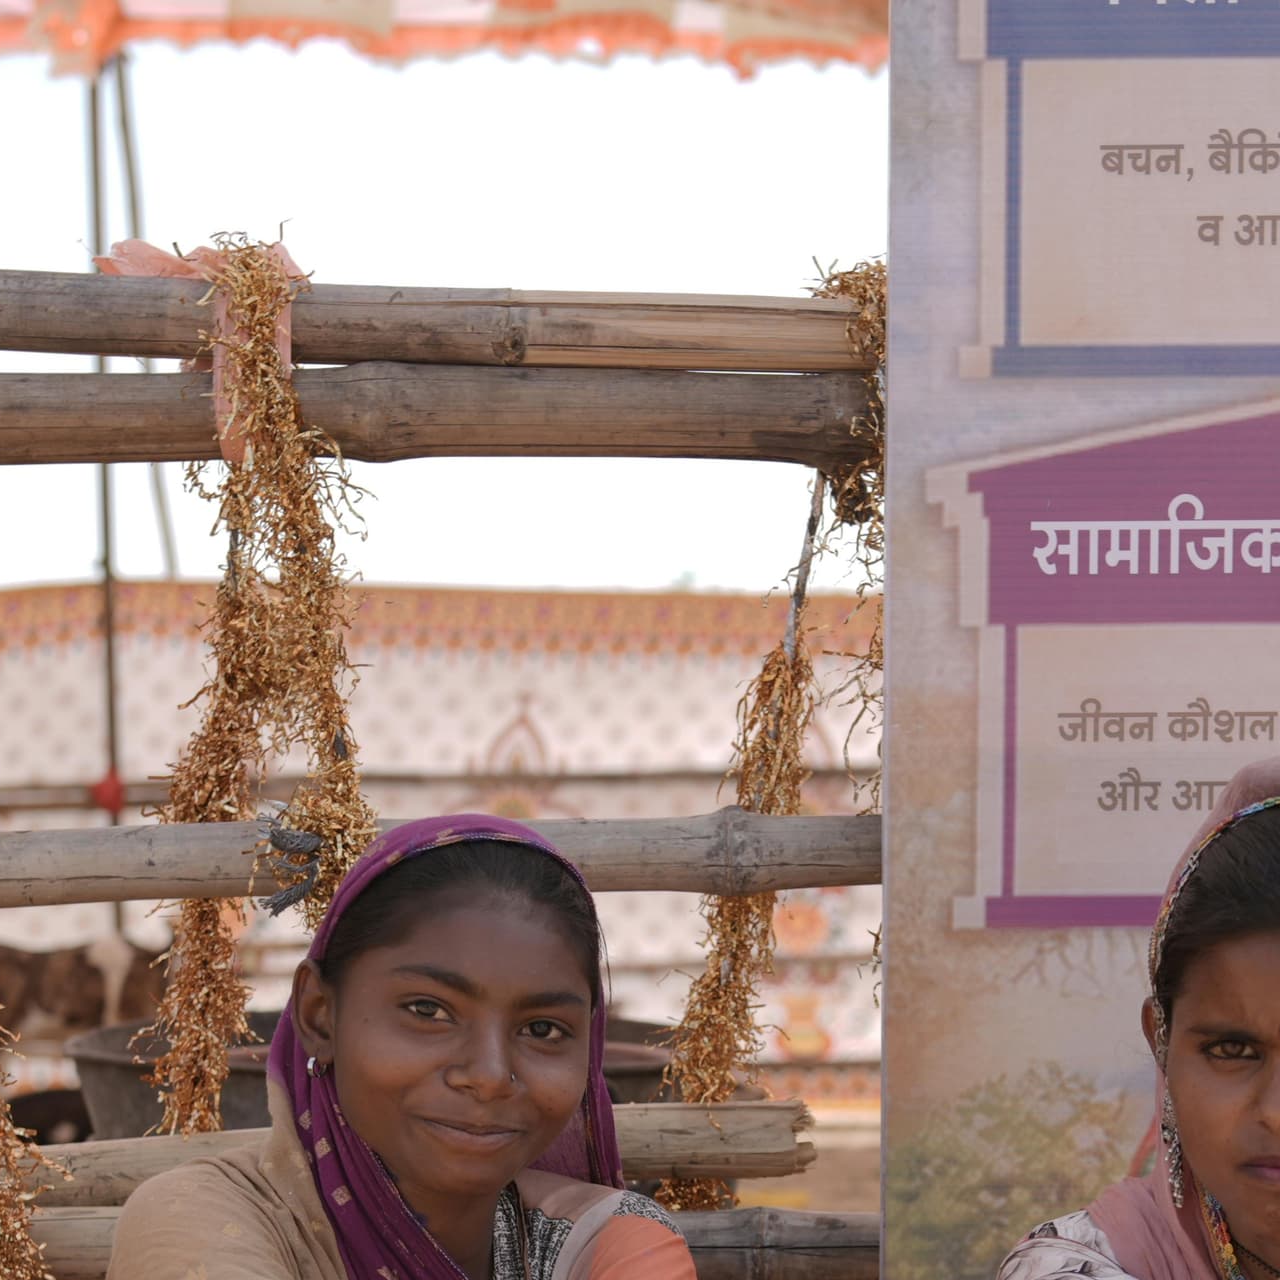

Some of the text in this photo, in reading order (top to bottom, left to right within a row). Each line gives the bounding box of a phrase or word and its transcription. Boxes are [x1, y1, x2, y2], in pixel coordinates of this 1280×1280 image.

[1099, 144, 1195, 182] बचन,
[1196, 215, 1224, 247] व
[1057, 697, 1158, 743] जीवन
[1167, 697, 1278, 743] कौशल
[1096, 767, 1161, 812] और
